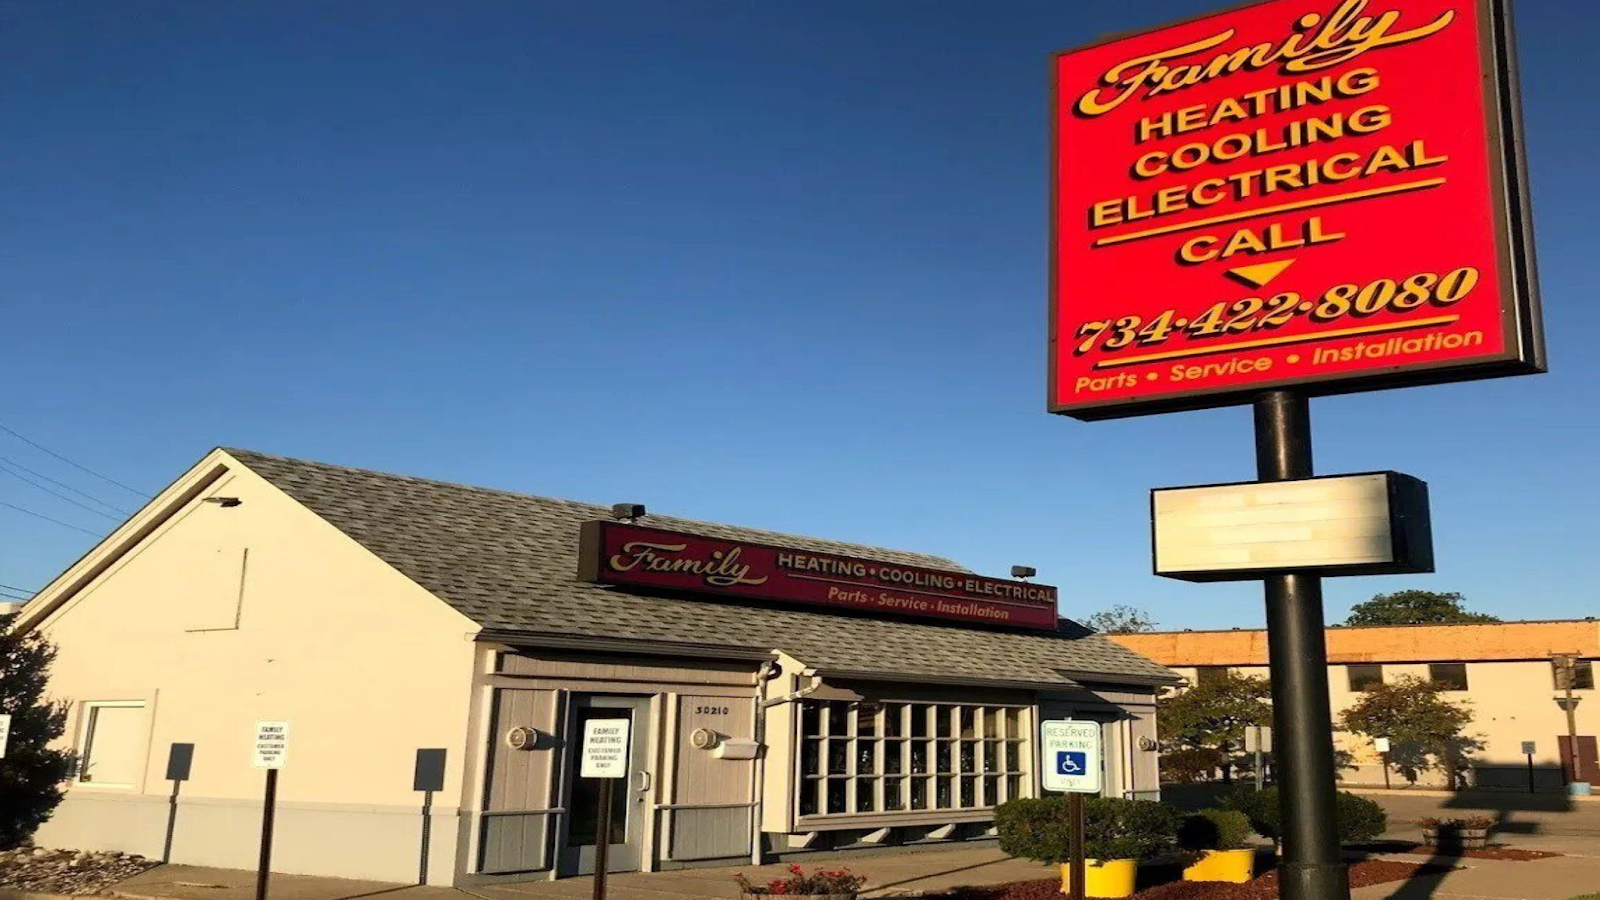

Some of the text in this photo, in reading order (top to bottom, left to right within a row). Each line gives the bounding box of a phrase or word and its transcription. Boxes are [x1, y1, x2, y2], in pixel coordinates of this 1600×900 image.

[1077, 0, 1455, 116] Family
[1138, 67, 1380, 143] HEATING
[1133, 105, 1392, 179] COOLING
[1091, 140, 1449, 228] ELECTRICAL
[1179, 216, 1346, 264] CALL
[1075, 330, 1484, 393] Parts Service Installation
[609, 541, 769, 586] Family
[777, 552, 1055, 602] HEATING COOLING ELECTRICAL
[828, 586, 1010, 620] Parts Service Installation
[589, 736, 622, 744] HEATING
[593, 727, 620, 735] FAMILY
[1046, 727, 1096, 738] RESERVED
[1049, 740, 1093, 749] PARKING
